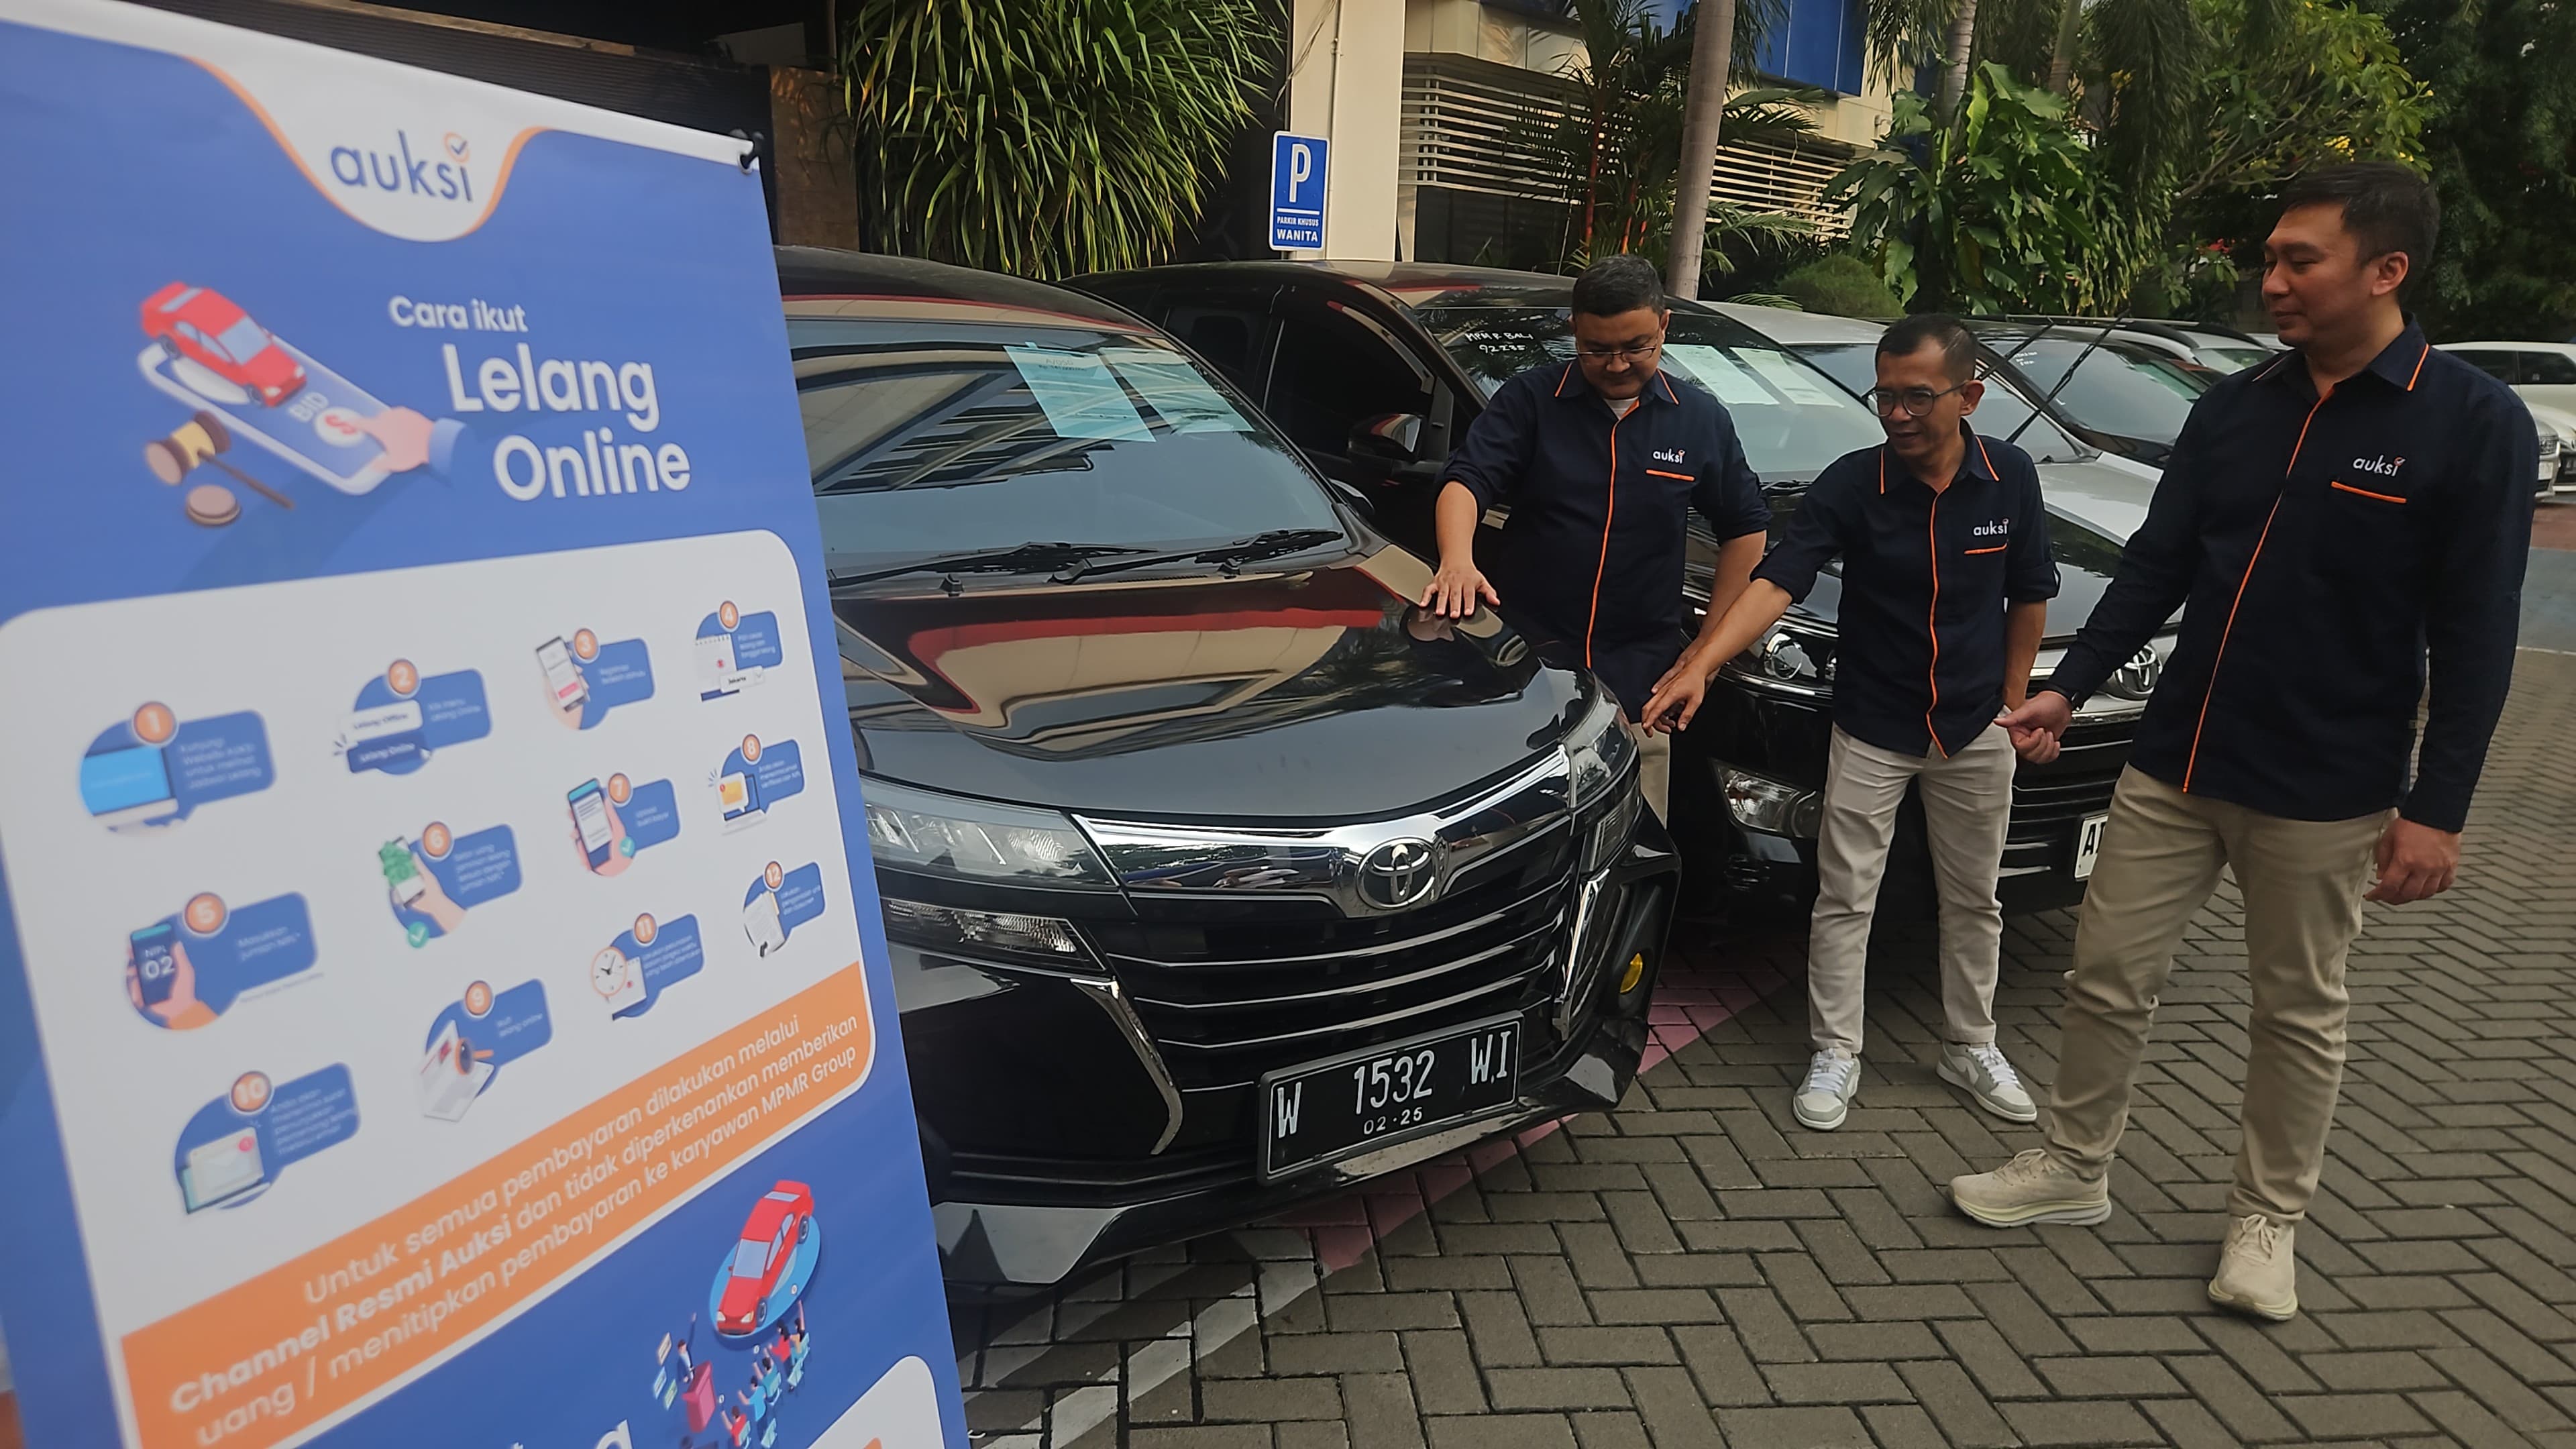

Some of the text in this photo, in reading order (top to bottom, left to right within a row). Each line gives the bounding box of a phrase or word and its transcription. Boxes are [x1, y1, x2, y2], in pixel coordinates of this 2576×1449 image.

[330, 130, 473, 202] auksi
[1289, 144, 1311, 203] P
[1277, 216, 1319, 227] PARKIR KHUSUS
[1277, 229, 1318, 241] WANITA
[388, 296, 528, 332] Cara ikut
[443, 342, 660, 433] Lelang
[492, 427, 691, 502] Online
[1652, 448, 1685, 464] auksi
[2353, 455, 2406, 476] auksi
[1973, 519, 2009, 536] auksi
[581, 635, 592, 652] 3
[396, 667, 411, 686] 2
[747, 739, 756, 755] 8
[614, 778, 623, 797] 7
[429, 829, 444, 848] 6
[767, 866, 781, 883] 12
[195, 901, 216, 924] 5
[638, 918, 652, 937] 11
[144, 955, 176, 979] 02
[471, 987, 485, 1007] 9
[235, 1077, 268, 1106] 10
[1277, 1030, 1511, 1138] W 1532 WI
[305, 1014, 800, 1303] Untuk semua pembayaran dilakukan melalui
[170, 1014, 858, 1413] Channel Resmi Auksi dan tidak diperkenankan memberikan
[197, 1045, 857, 1446] uang / menitipkan pembayaran ke karyawan MPMR Group
